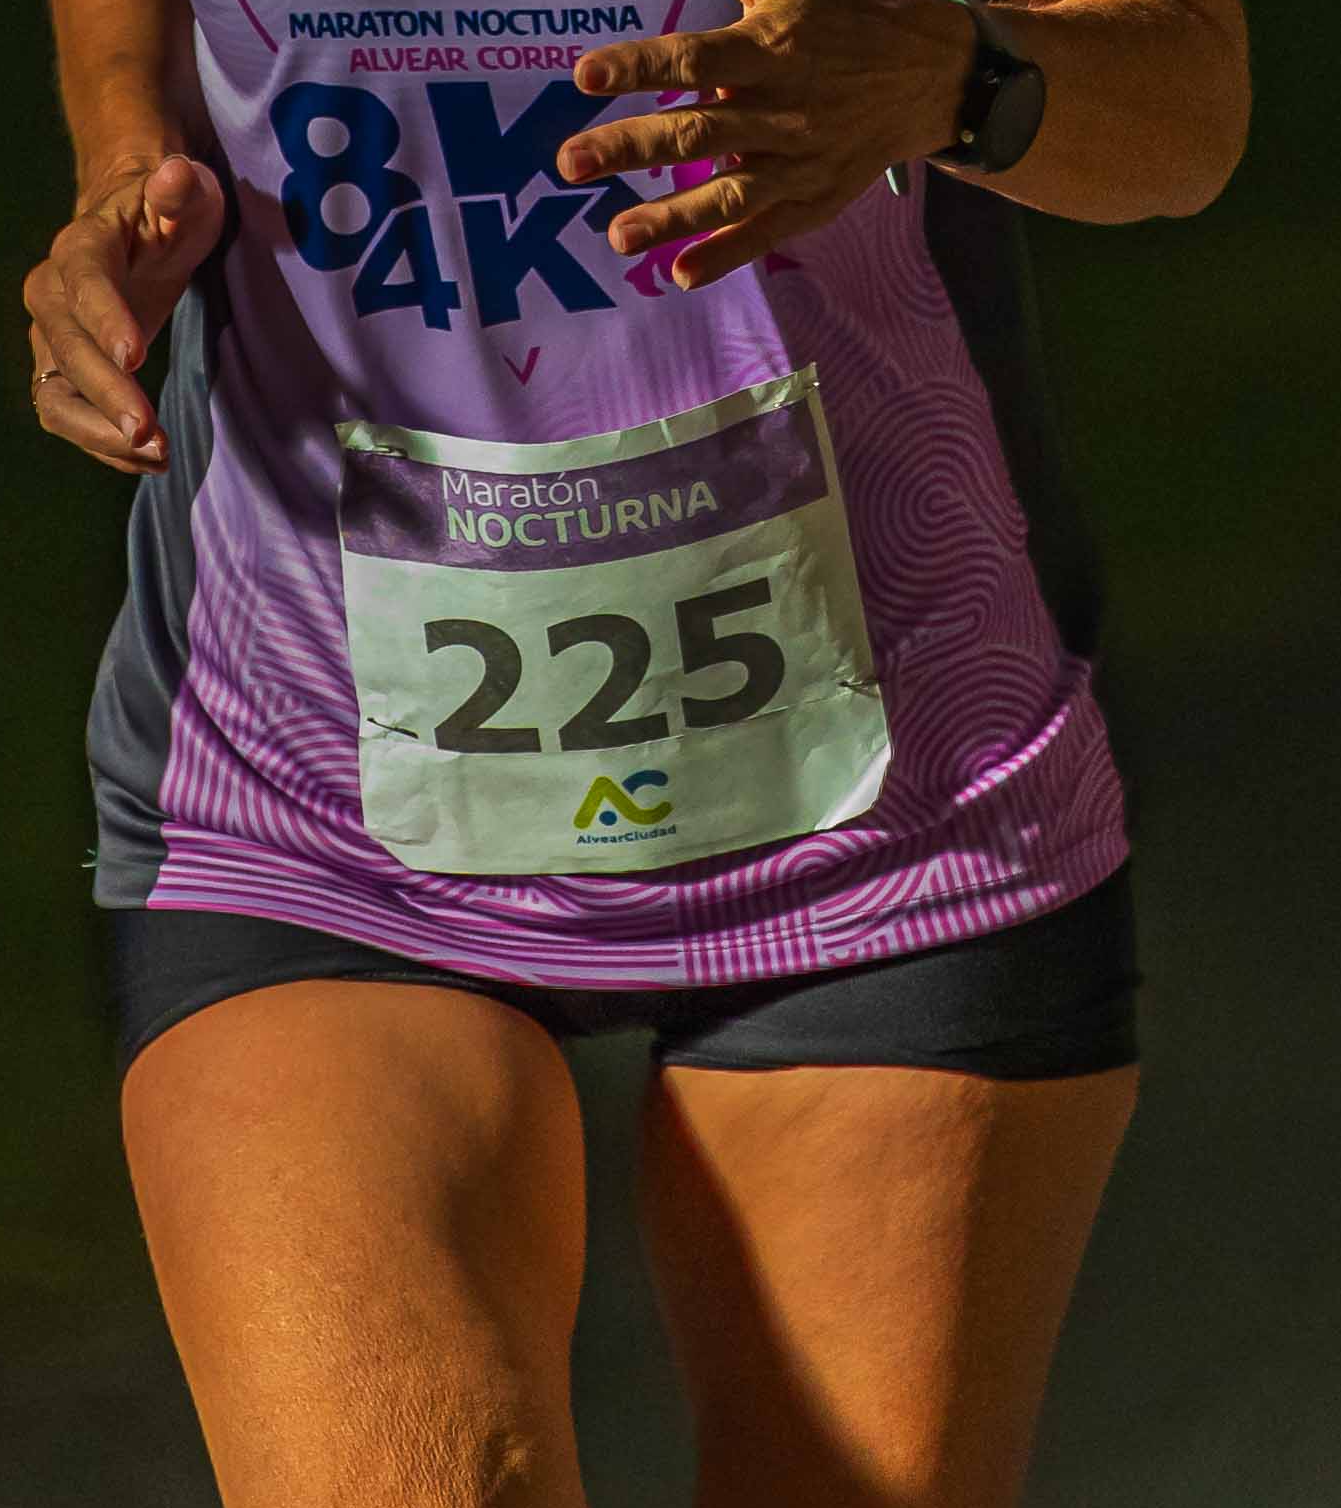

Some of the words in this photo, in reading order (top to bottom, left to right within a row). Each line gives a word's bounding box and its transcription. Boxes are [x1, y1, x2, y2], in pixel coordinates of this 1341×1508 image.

[288, 9, 444, 39] MARATON
[458, 4, 644, 37] NOCTURNA
[348, 45, 470, 74] ALVEAR
[268, 80, 648, 272] 8K
[351, 194, 619, 333] 4K
[440, 469, 601, 509] Maratón
[445, 480, 720, 550] NOCTURNA
[422, 576, 787, 754] 225
[576, 824, 677, 845] AlvearCiudad
